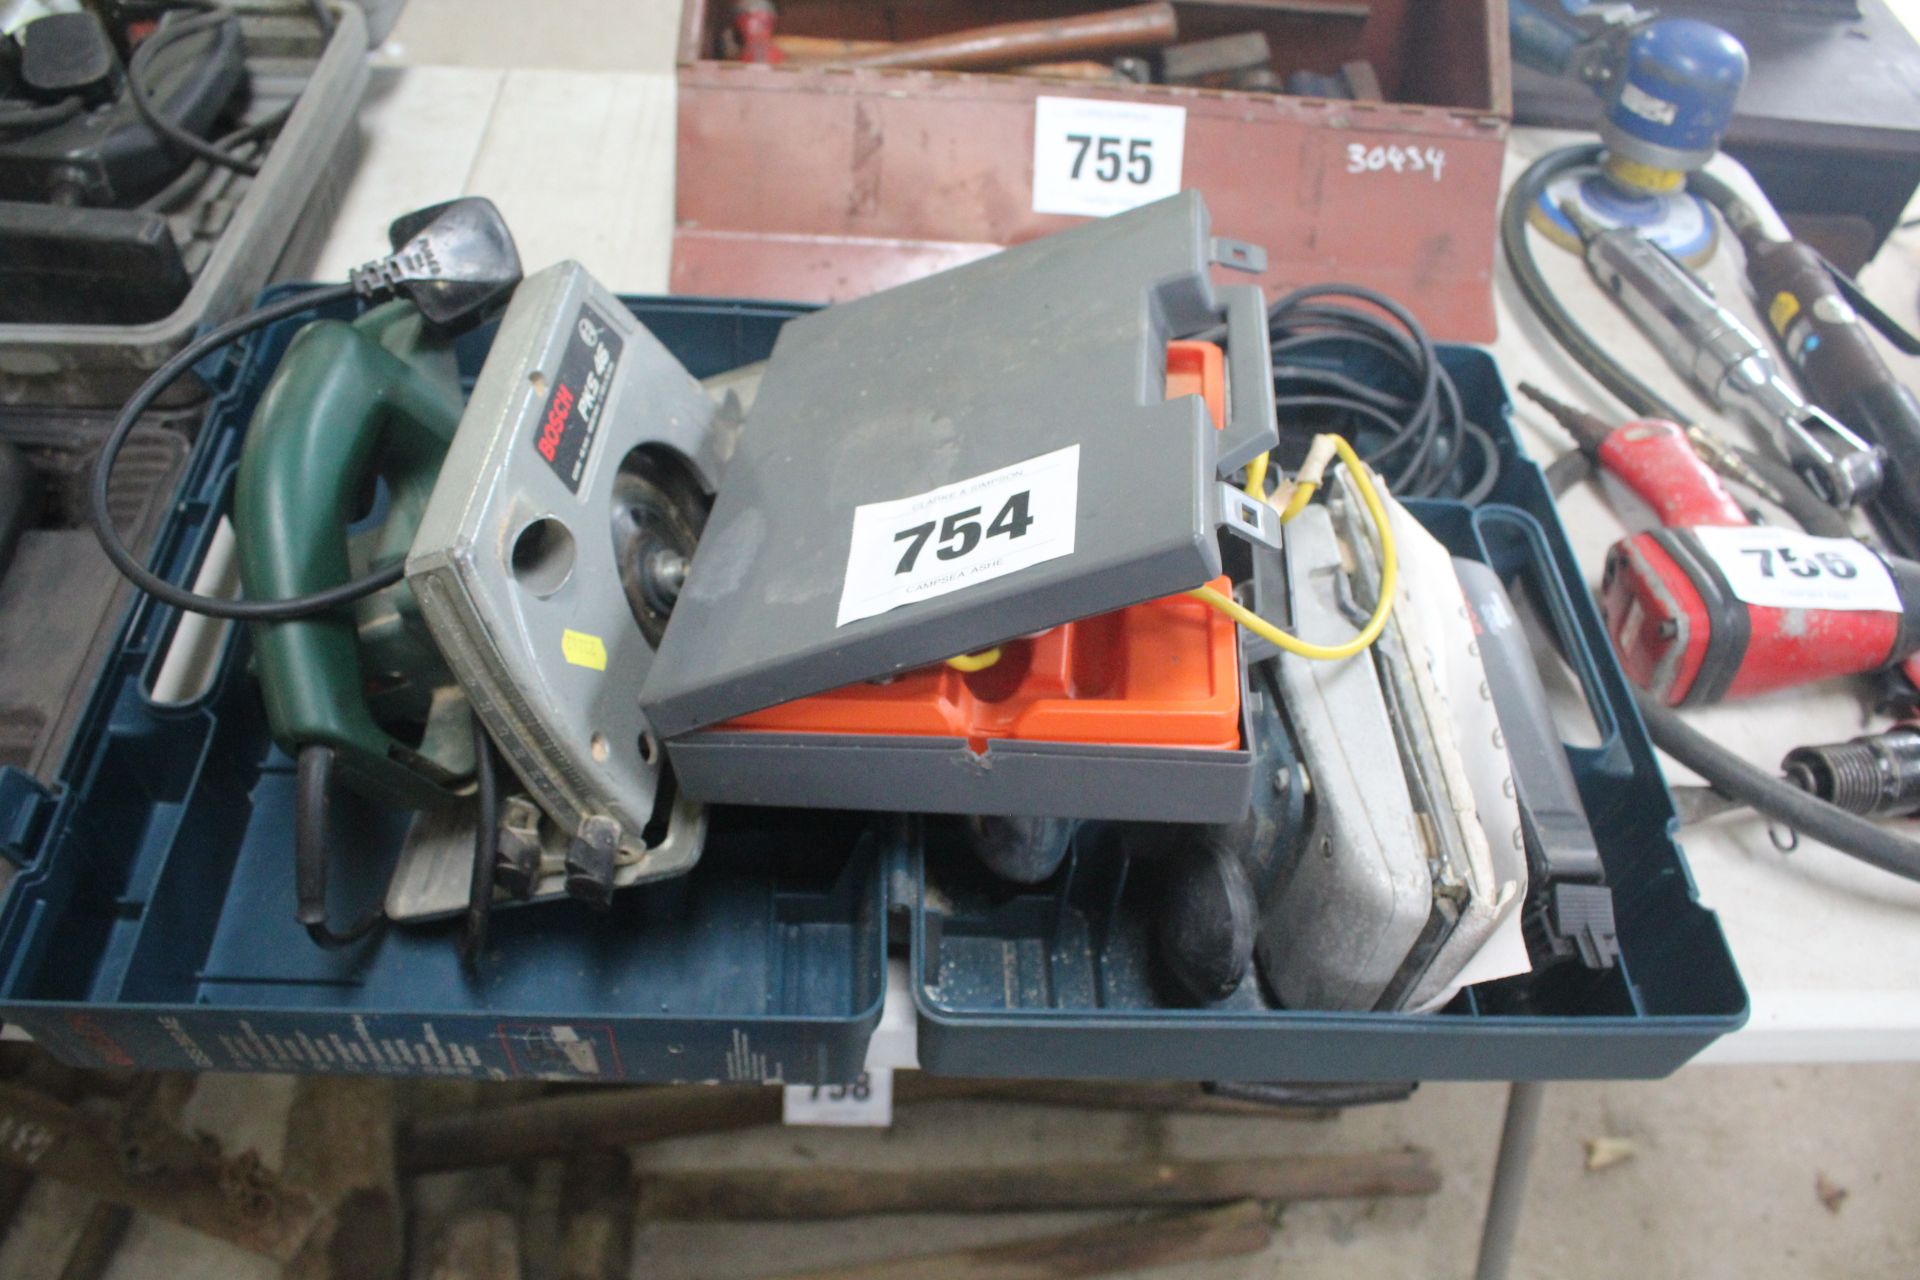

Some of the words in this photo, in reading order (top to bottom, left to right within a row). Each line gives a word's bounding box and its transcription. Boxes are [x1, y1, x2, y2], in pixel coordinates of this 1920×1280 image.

[1066, 133, 1153, 185] 755
[577, 371, 600, 422] PKS
[537, 383, 574, 462] BOSCH
[894, 490, 1034, 576] 754
[905, 570, 966, 594] CAMPSEA
[971, 558, 1003, 575] ASHE
[1738, 547, 1858, 580] 756
